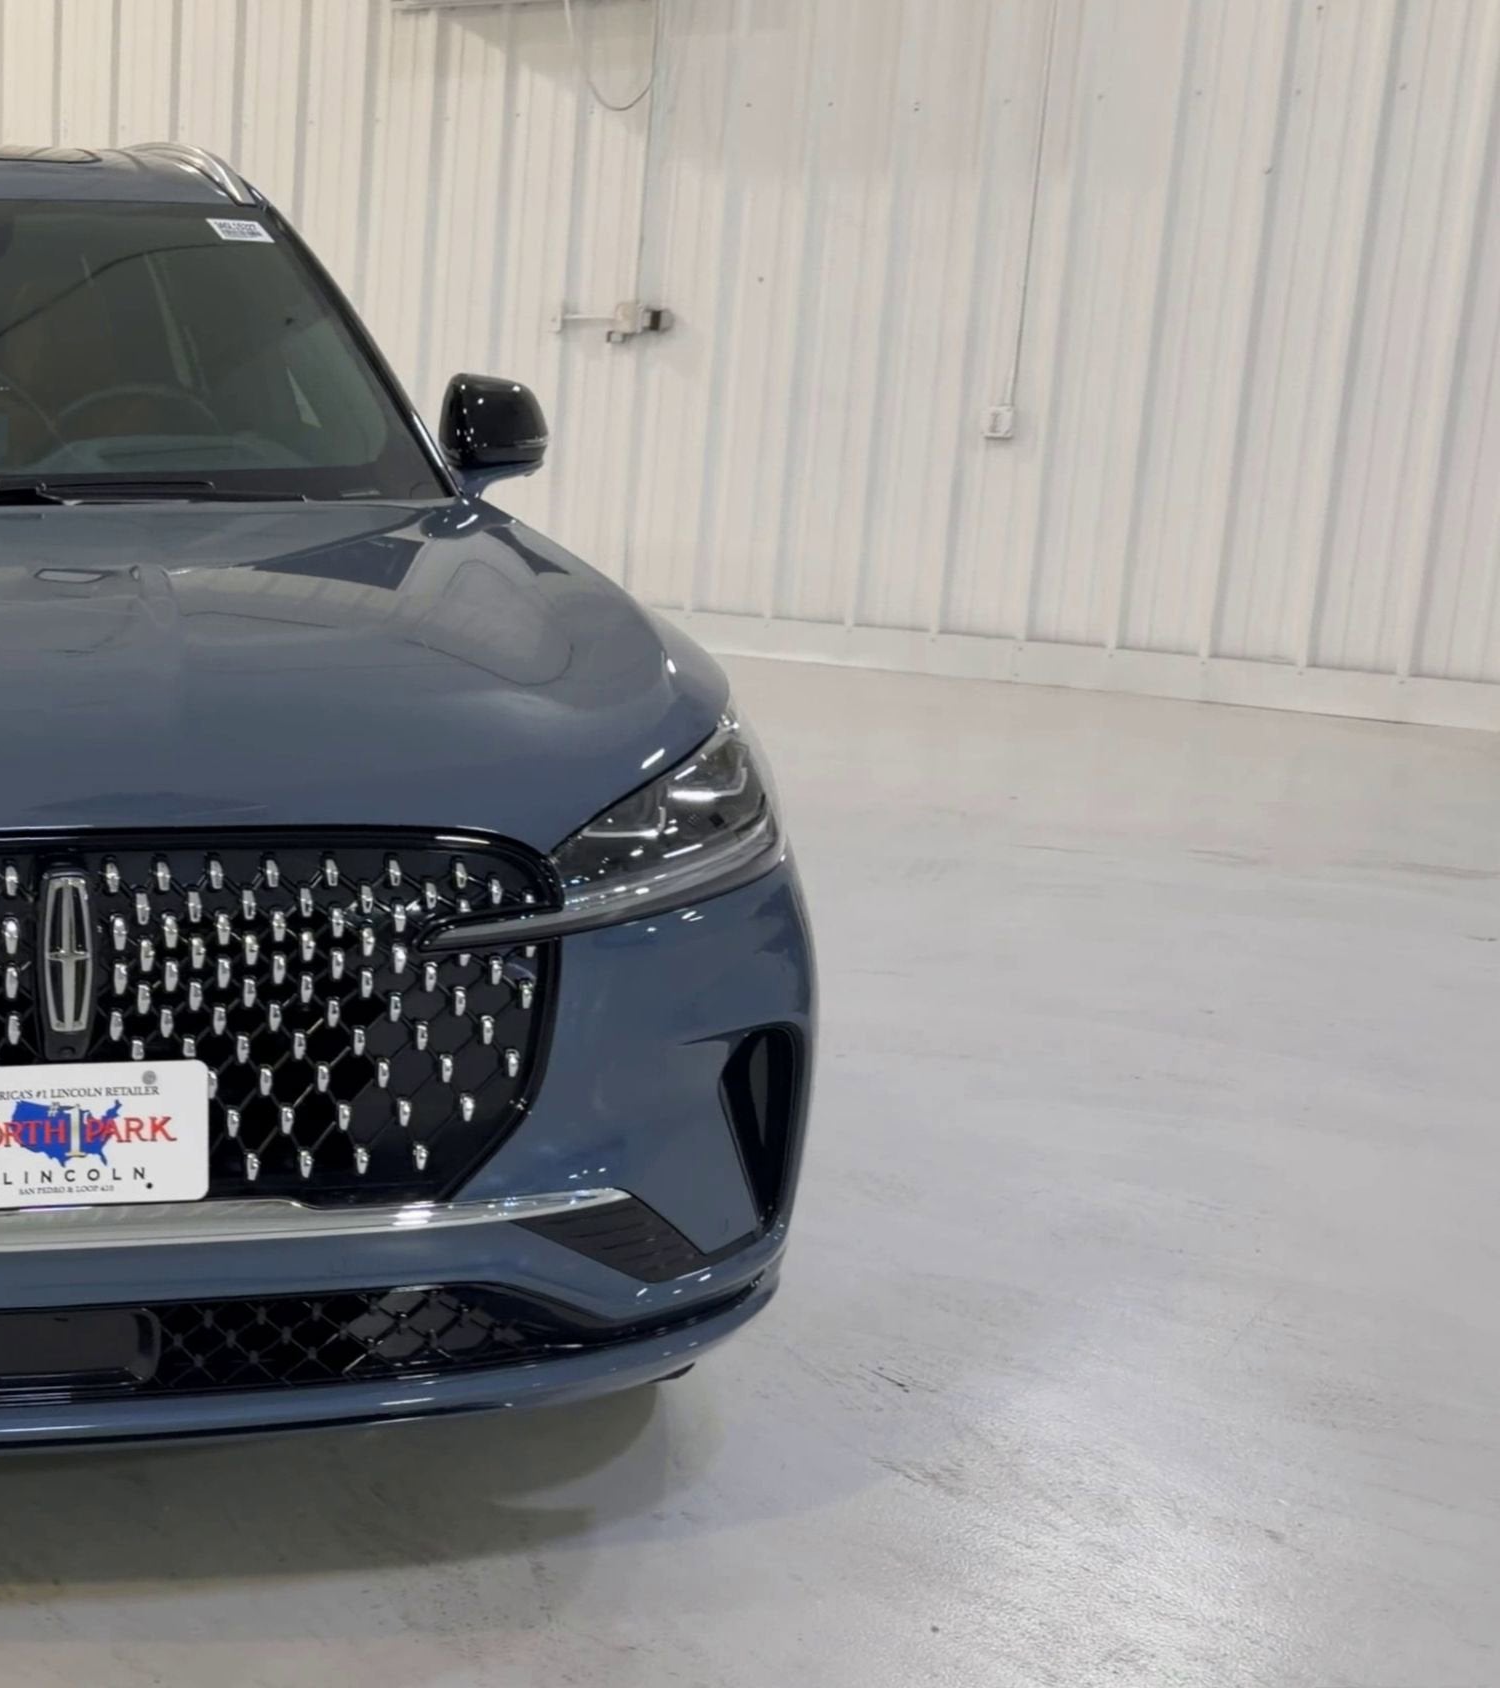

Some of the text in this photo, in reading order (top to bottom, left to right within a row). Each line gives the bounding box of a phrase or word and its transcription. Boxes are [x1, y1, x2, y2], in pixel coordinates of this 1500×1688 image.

[35, 1089, 47, 1099] #1
[50, 1086, 102, 1099] LINCOLN
[105, 1084, 160, 1097] RETAILER
[84, 1116, 177, 1144] PARK
[3, 1166, 146, 1186] LINCOLN
[37, 1186, 65, 1195] PEDRO
